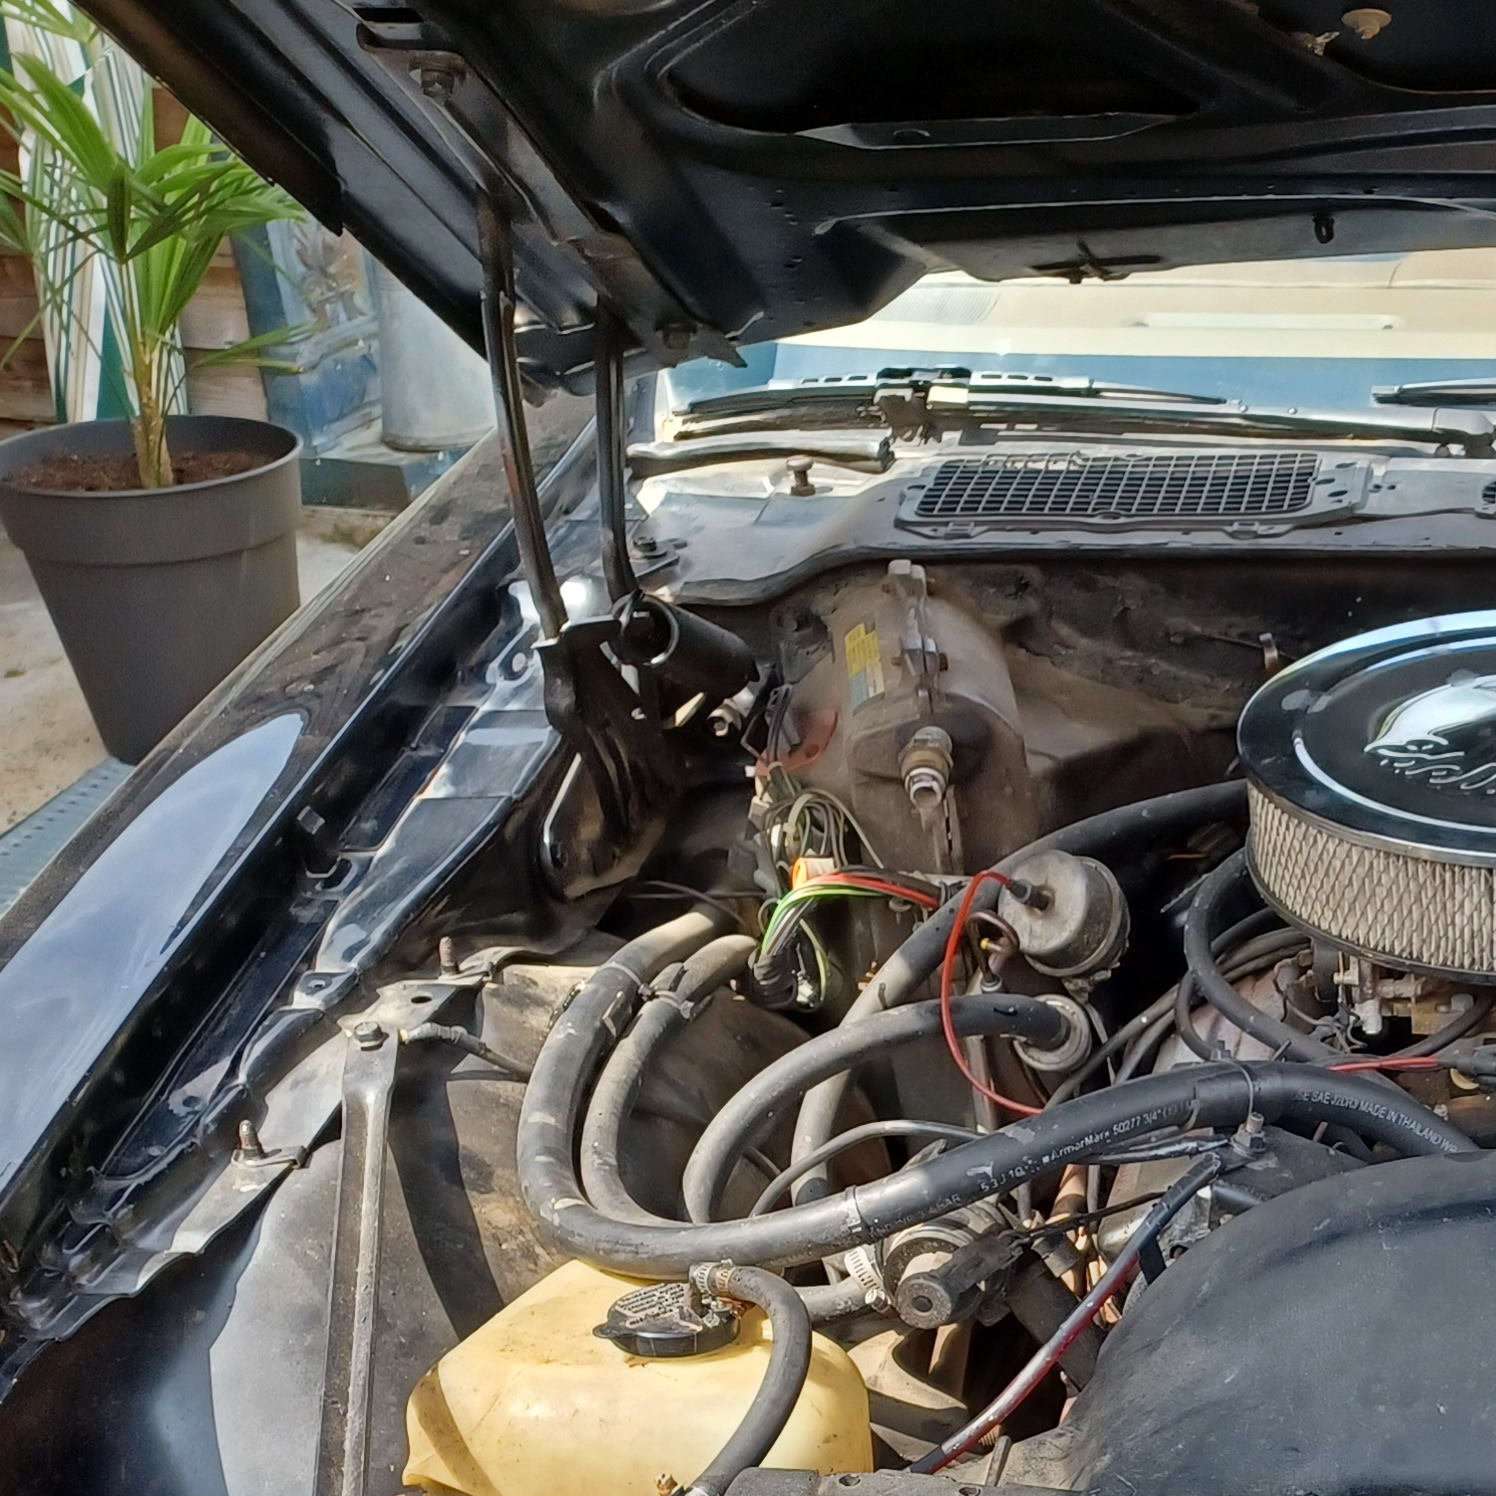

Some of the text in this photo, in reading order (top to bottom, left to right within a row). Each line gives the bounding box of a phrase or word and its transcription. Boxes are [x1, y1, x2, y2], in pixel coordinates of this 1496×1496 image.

[1358, 1099, 1386, 1119] MADE
[1386, 1110, 1398, 1124] IN
[1397, 1114, 1442, 1145] THAILAND
